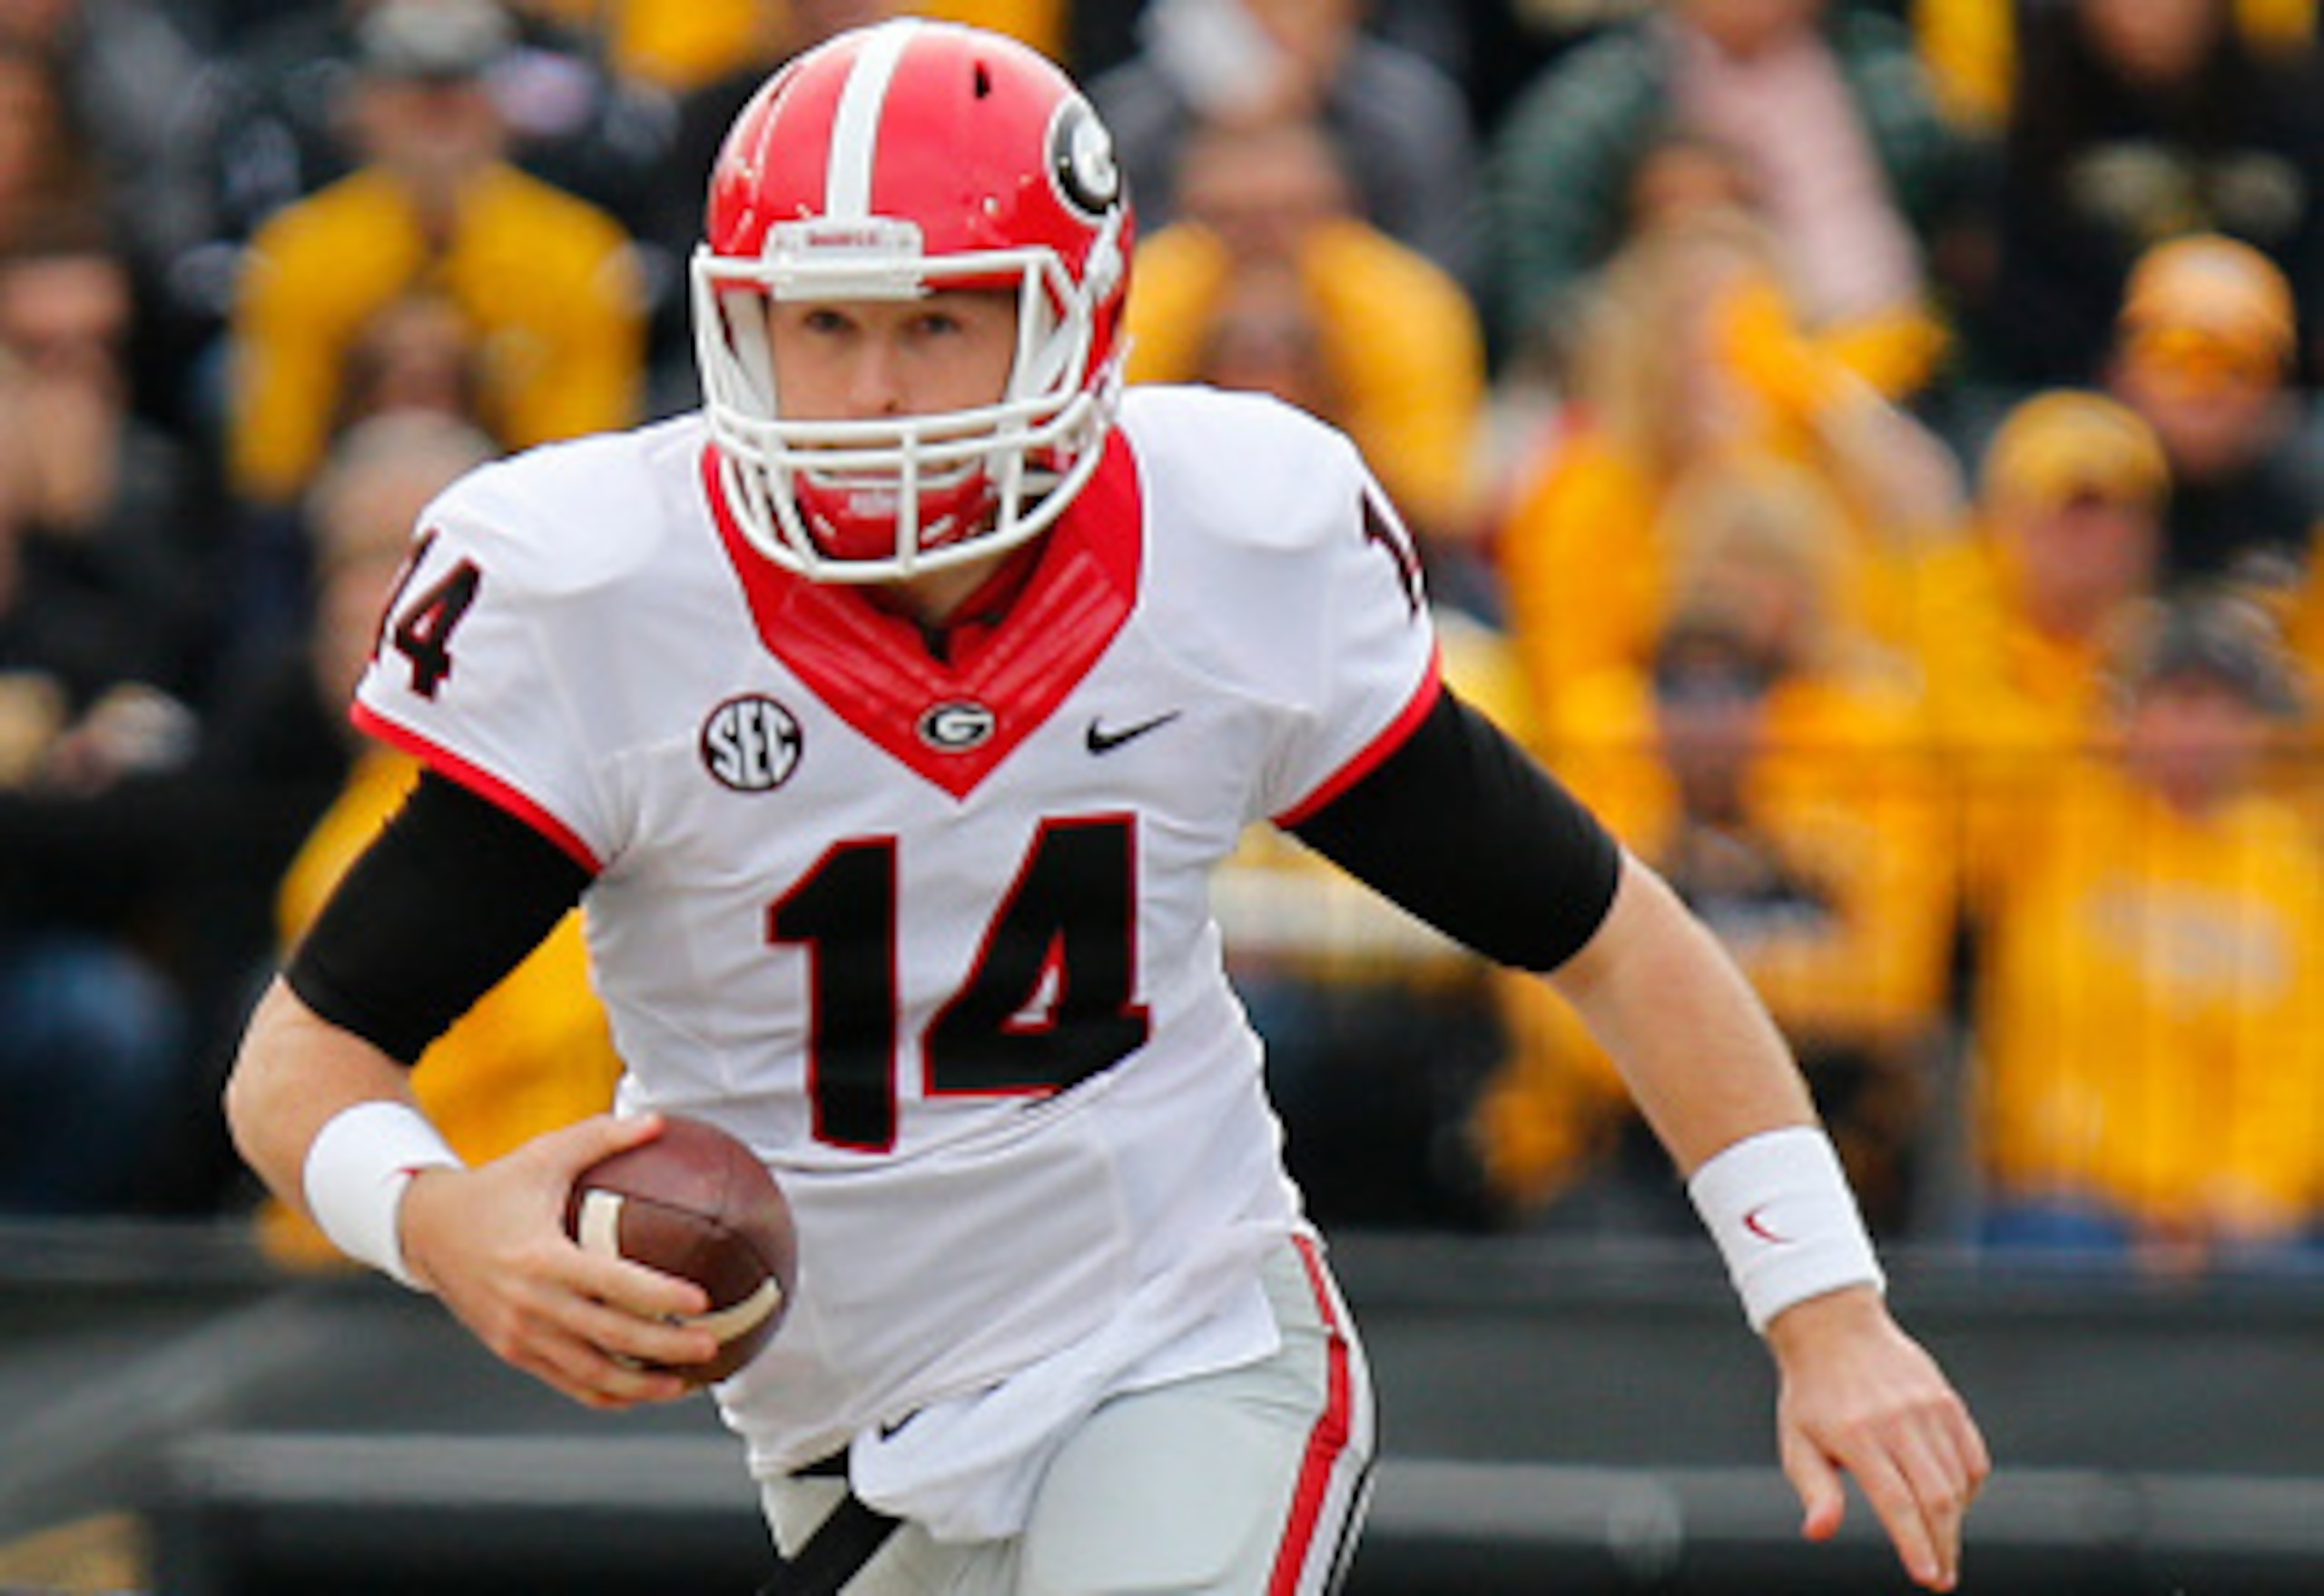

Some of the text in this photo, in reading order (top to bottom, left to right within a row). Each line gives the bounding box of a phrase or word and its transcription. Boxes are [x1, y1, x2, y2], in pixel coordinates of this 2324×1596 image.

[1362, 488, 1430, 626] 1
[705, 699, 799, 789] SEC
[935, 709, 994, 743] G
[765, 811, 1152, 1154] 14
